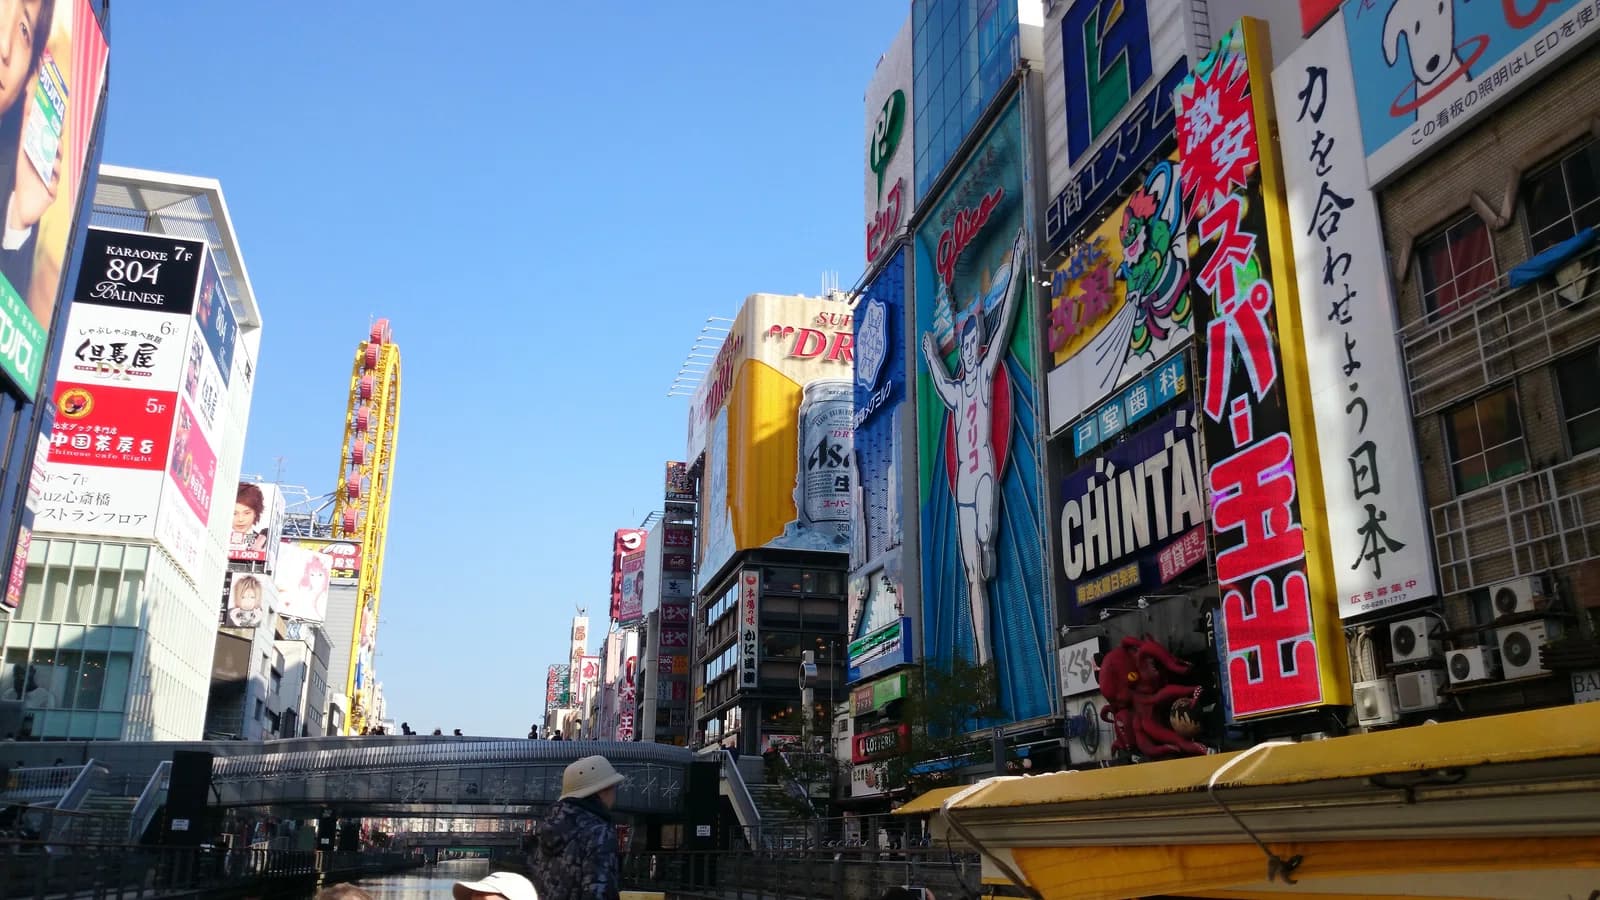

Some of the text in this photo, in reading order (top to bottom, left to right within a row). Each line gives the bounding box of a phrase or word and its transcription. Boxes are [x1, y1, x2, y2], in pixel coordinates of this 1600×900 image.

[1184, 88, 1251, 181] 激安
[936, 186, 1004, 287] Glico
[106, 245, 193, 262] KARAOKE 7F
[106, 258, 162, 286] 804
[90, 281, 165, 305] BALINESE
[74, 337, 158, 368] 但馬屋
[145, 398, 167, 414] 5F
[1077, 363, 1179, 456] 戸堂歯科
[967, 397, 979, 474] グリコ
